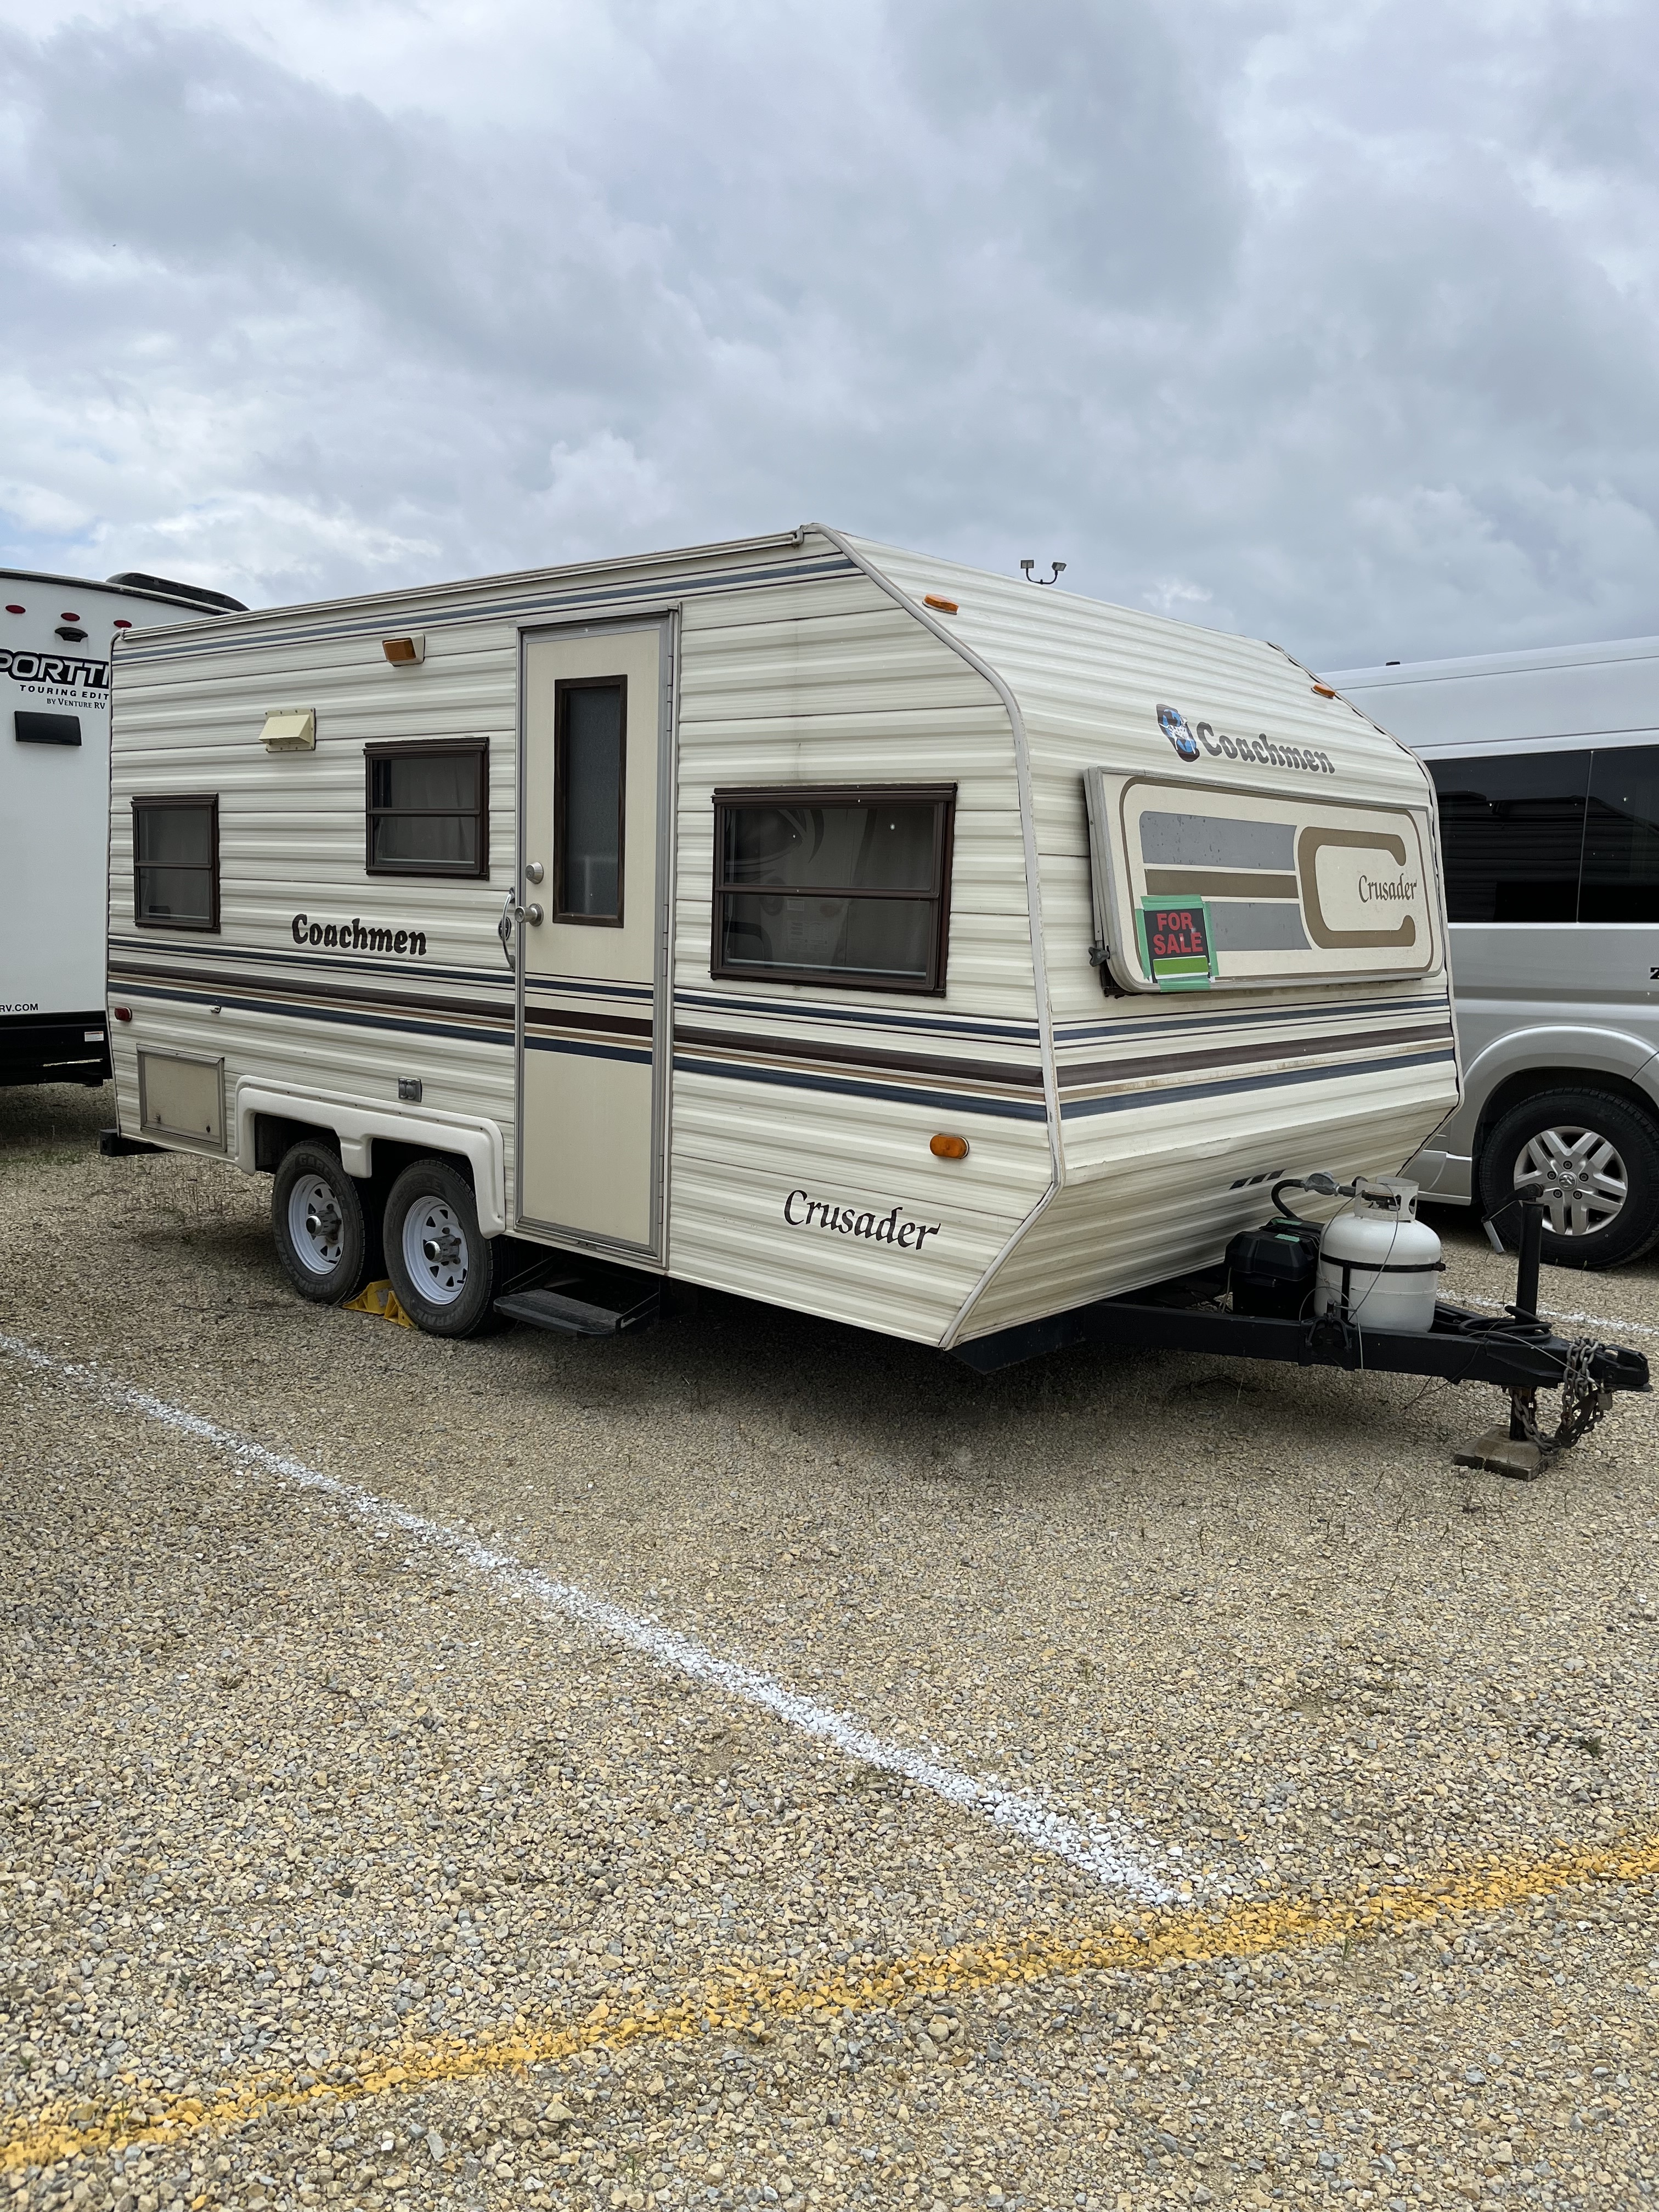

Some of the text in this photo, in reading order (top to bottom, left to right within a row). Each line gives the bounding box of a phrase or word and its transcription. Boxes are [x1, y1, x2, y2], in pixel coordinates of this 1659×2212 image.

[20, 684, 109, 700] TOURING EDIT
[58, 698, 93, 708] VENTURE
[94, 701, 106, 709] RV
[1196, 721, 1335, 774] Coachmen
[1358, 872, 1418, 903] Crusader
[1156, 912, 1194, 932] FOR
[292, 913, 427, 956] Coachmen
[1153, 932, 1203, 955] SALE
[0, 1003, 38, 1012] RV.COM
[783, 1189, 941, 1250] Crusader
